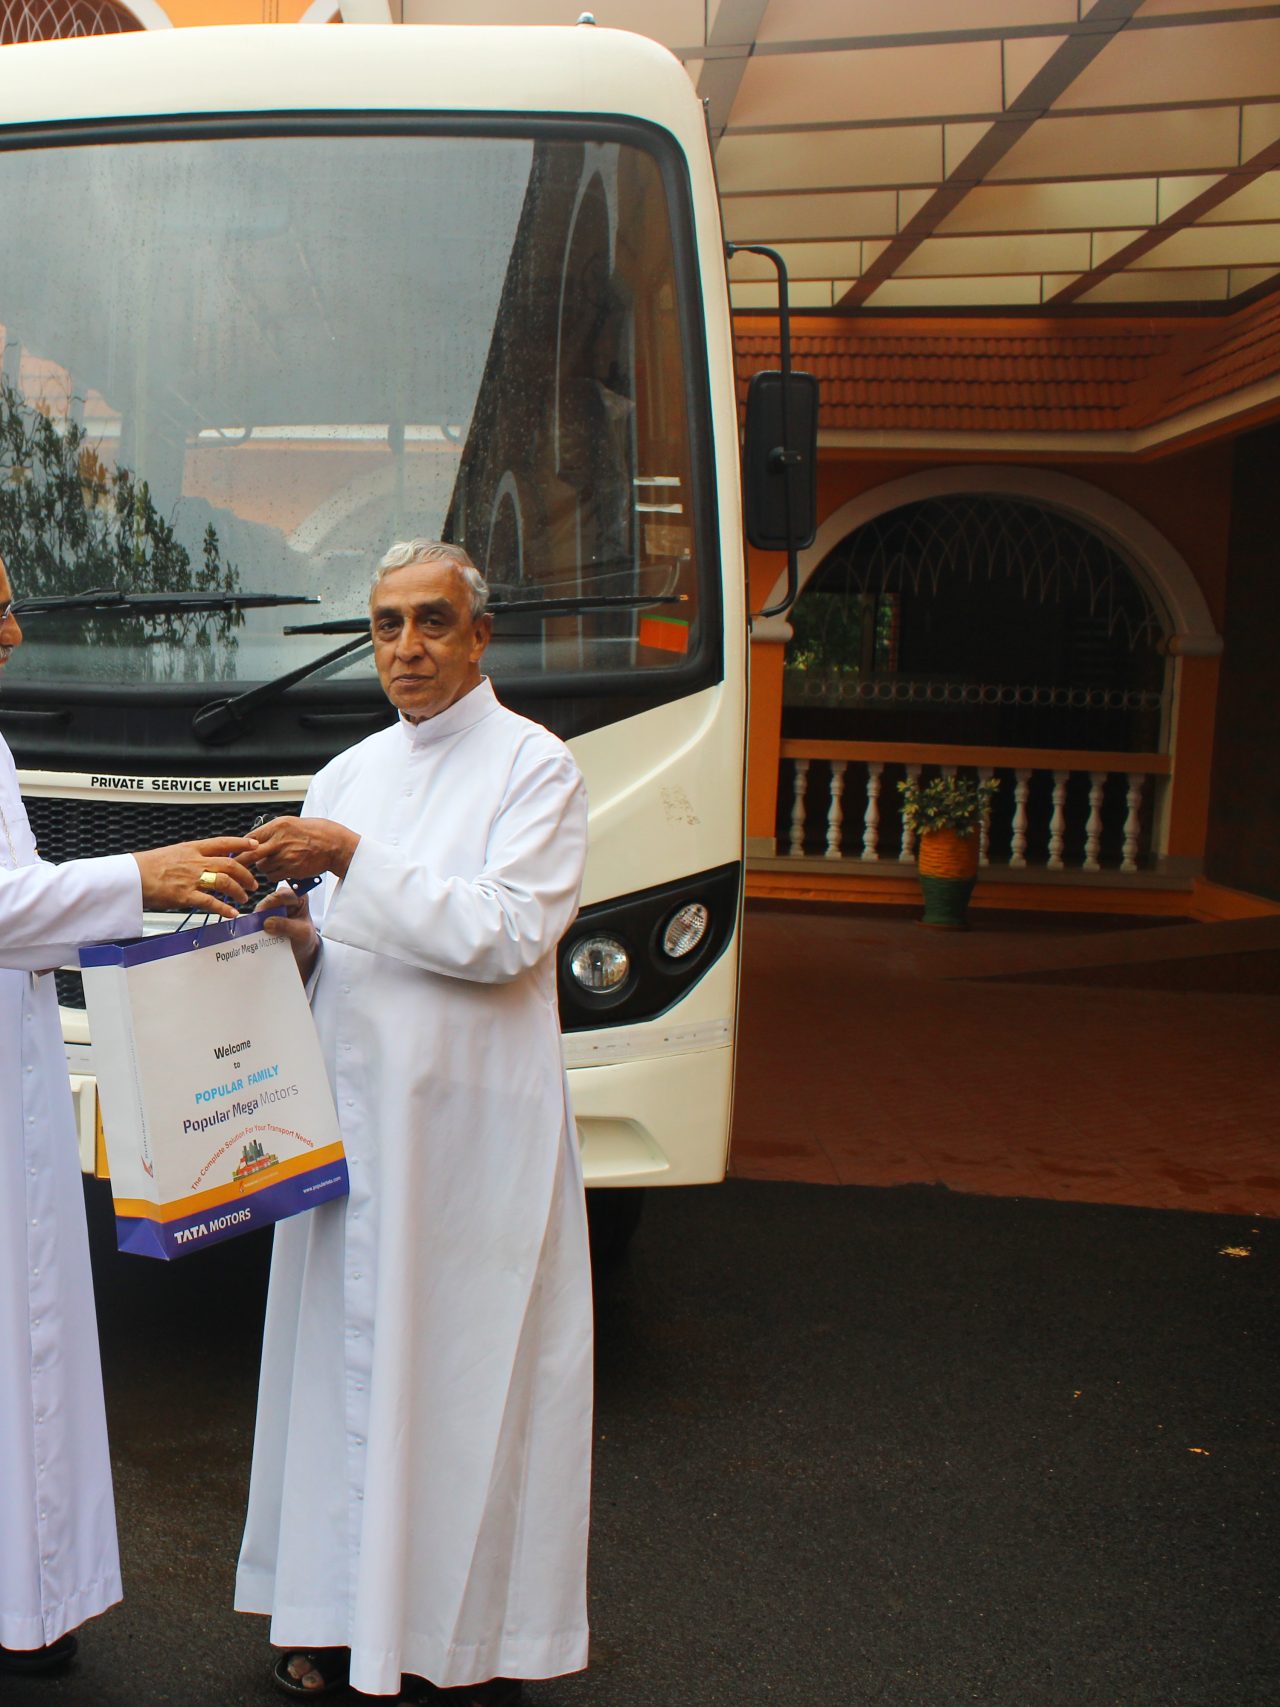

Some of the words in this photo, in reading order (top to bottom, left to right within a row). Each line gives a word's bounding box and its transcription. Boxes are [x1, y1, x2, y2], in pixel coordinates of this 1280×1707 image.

[91, 776, 144, 790] PRIVATE
[152, 779, 212, 792] SERVICE
[219, 778, 279, 792] VEHICLE
[215, 946, 241, 962] Popular
[241, 942, 259, 955] Mega
[259, 935, 286, 950] Motors
[214, 1039, 252, 1060] Welcome
[233, 1061, 241, 1069] to
[195, 1078, 244, 1105] POPULAR
[247, 1064, 279, 1086] FAMILY
[183, 1109, 231, 1134] Popular
[232, 1099, 259, 1118] Mega
[260, 1084, 299, 1107] Motors
[191, 1177, 202, 1190] The
[200, 1147, 225, 1176] Complete
[224, 1130, 246, 1149] Solution
[245, 1126, 254, 1135] For
[255, 1124, 266, 1132] Your
[267, 1123, 295, 1138] Transport
[295, 1132, 314, 1148] Needs
[174, 1223, 208, 1244] TATA
[209, 1207, 252, 1233] MOTORS
